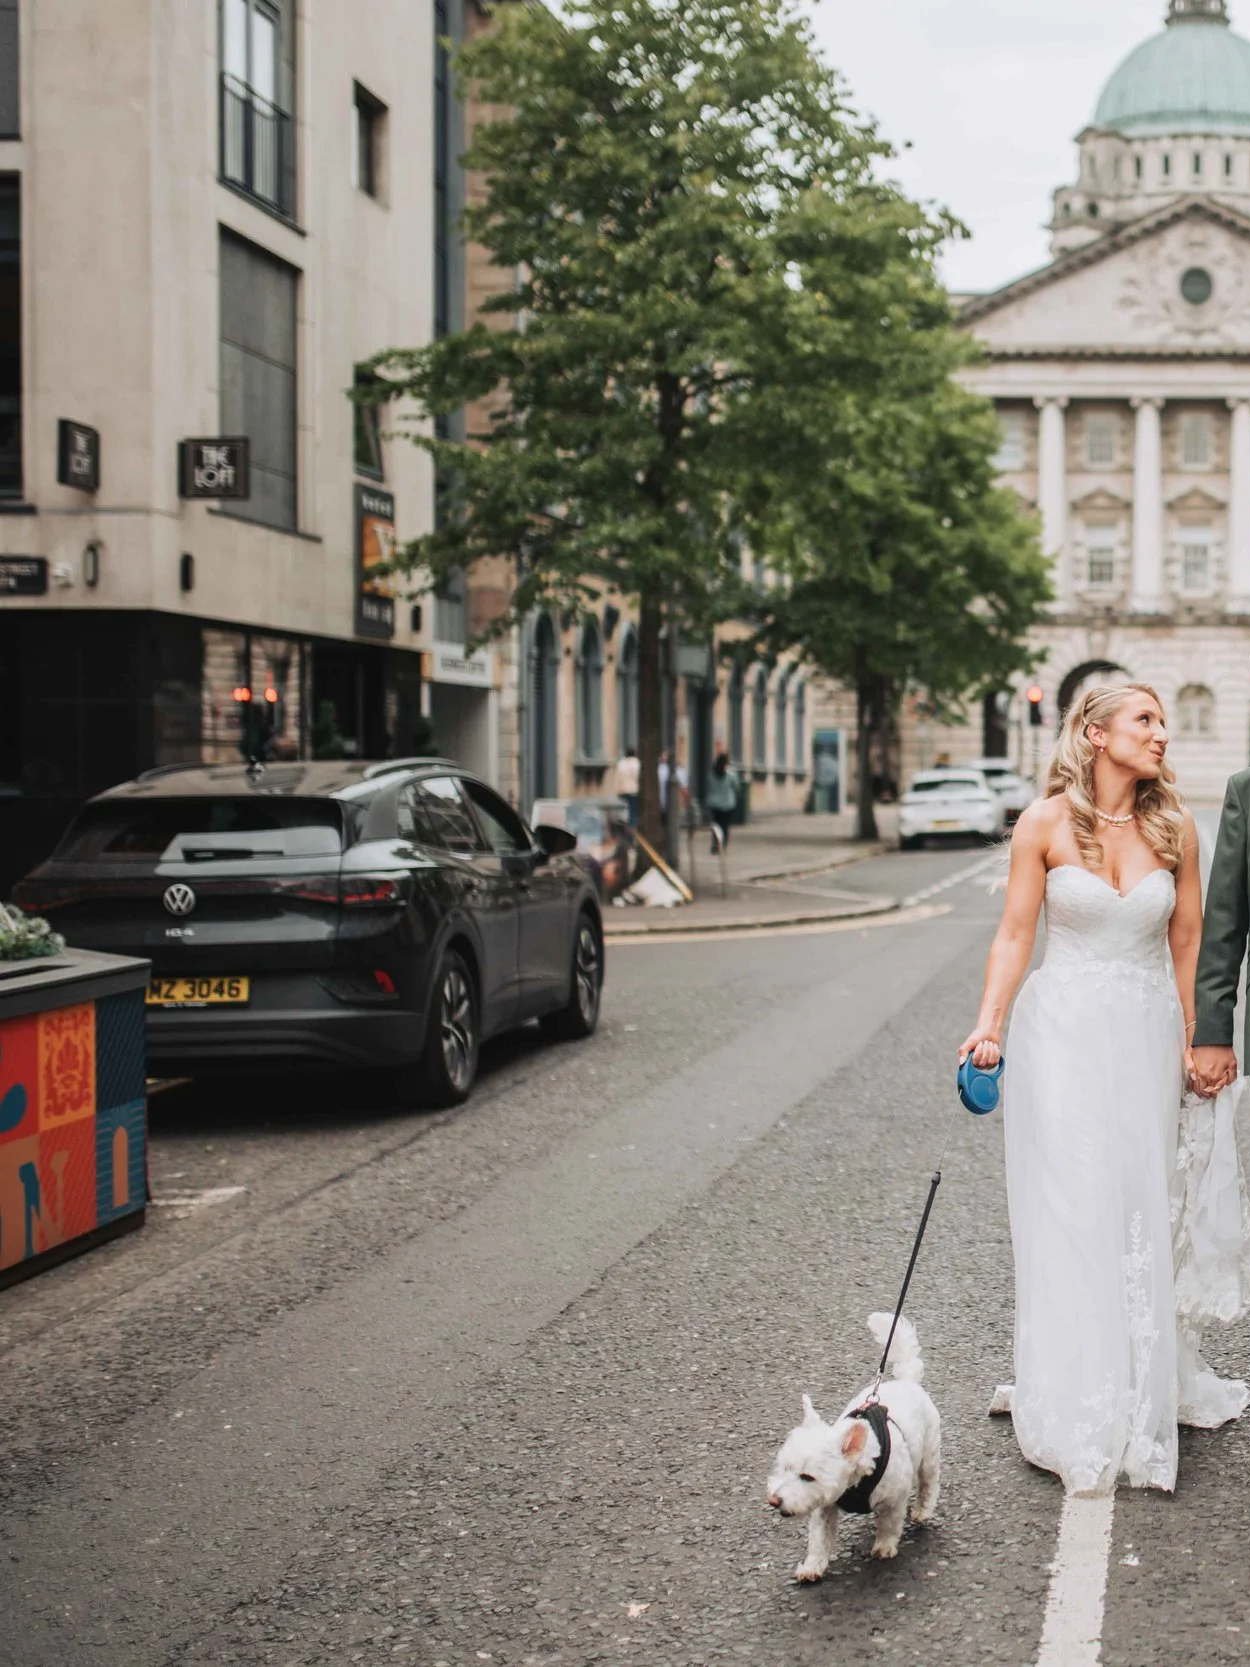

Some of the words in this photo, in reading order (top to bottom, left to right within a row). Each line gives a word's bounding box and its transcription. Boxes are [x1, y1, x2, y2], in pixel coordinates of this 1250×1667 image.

[202, 445, 230, 466] THE
[195, 466, 235, 488] LOFT
[183, 979, 242, 999] 3046
